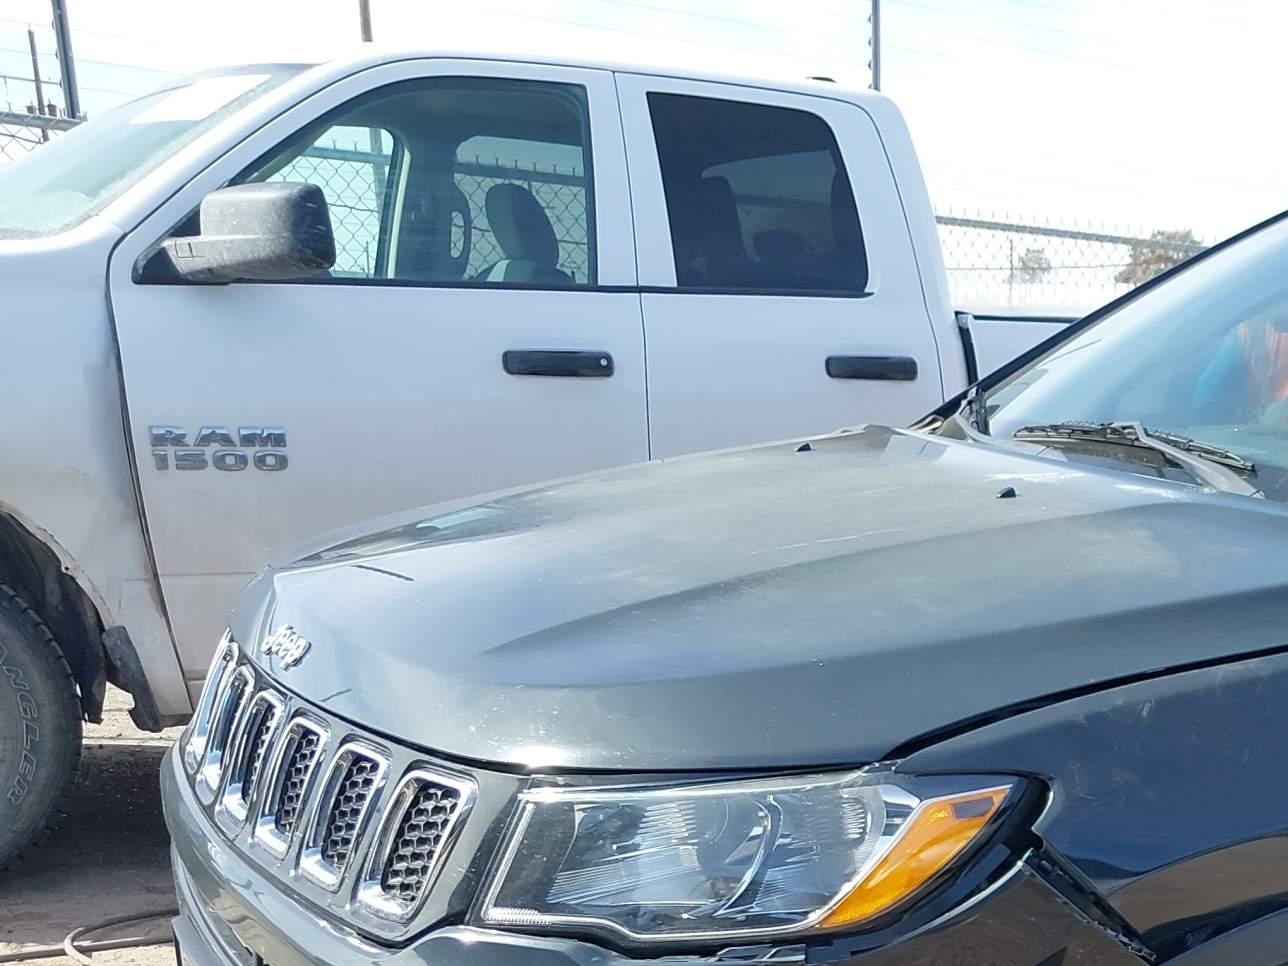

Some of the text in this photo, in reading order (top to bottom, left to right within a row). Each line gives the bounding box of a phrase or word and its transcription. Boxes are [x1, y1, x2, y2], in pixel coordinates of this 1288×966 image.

[149, 425, 287, 448] RAM
[152, 450, 289, 471] 1500
[261, 624, 311, 672] Jeep
